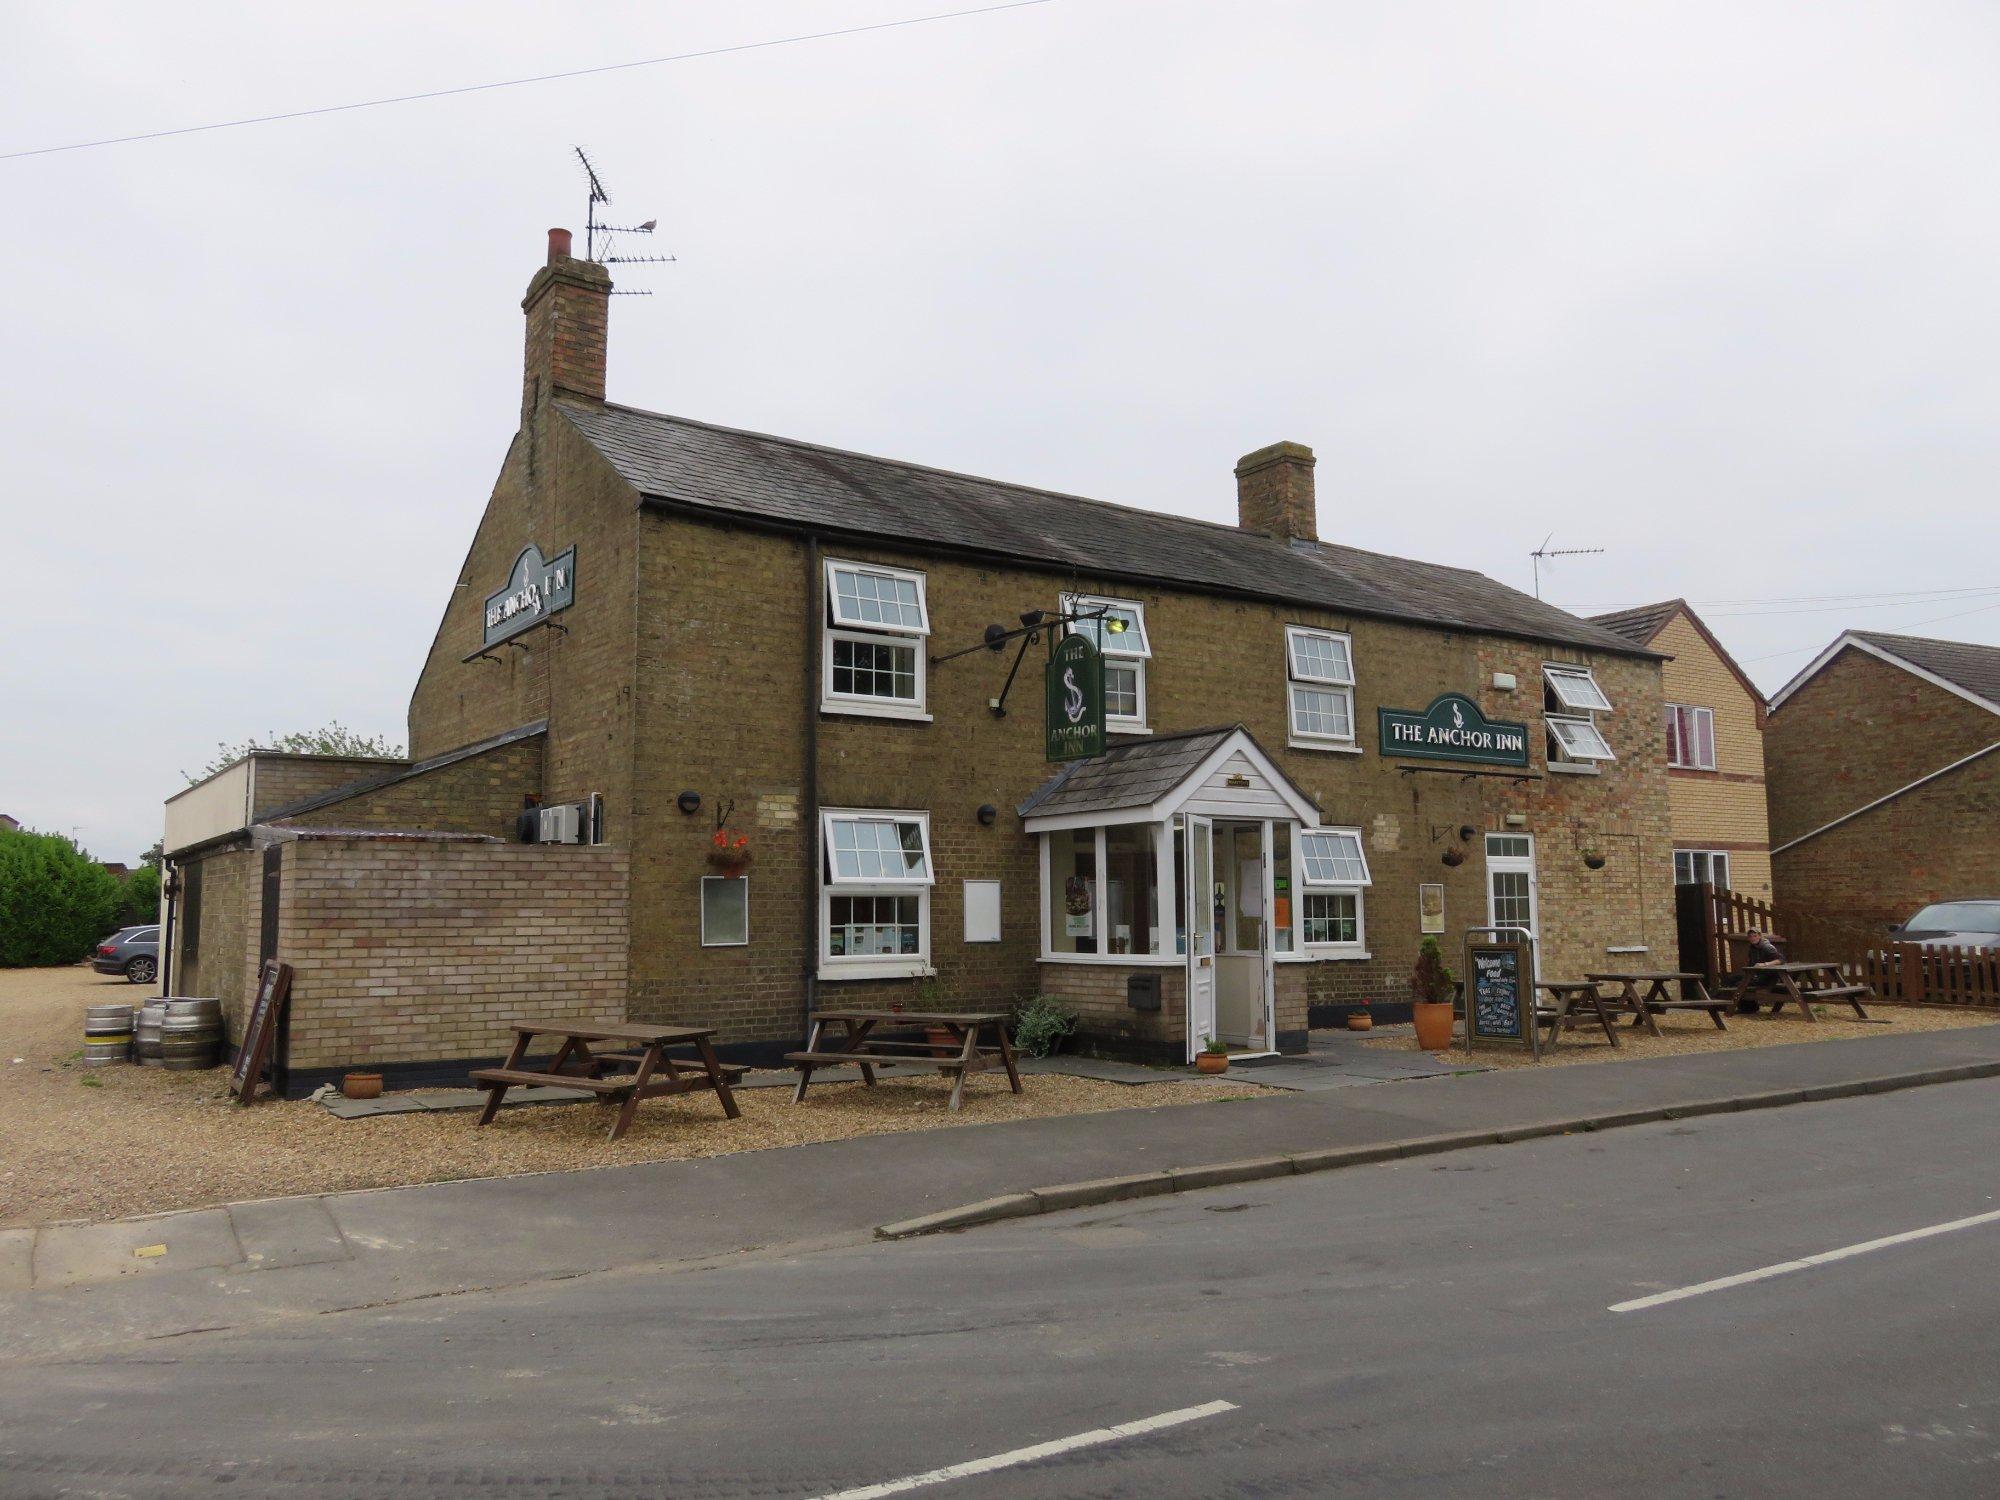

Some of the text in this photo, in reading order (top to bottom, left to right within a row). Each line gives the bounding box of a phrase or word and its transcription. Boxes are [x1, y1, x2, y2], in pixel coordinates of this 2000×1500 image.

[1064, 646, 1084, 661] THE
[1051, 725, 1097, 742] ANCHOR
[1392, 723, 1523, 751] THE ANCHOR INN
[1065, 740, 1084, 753] INN
